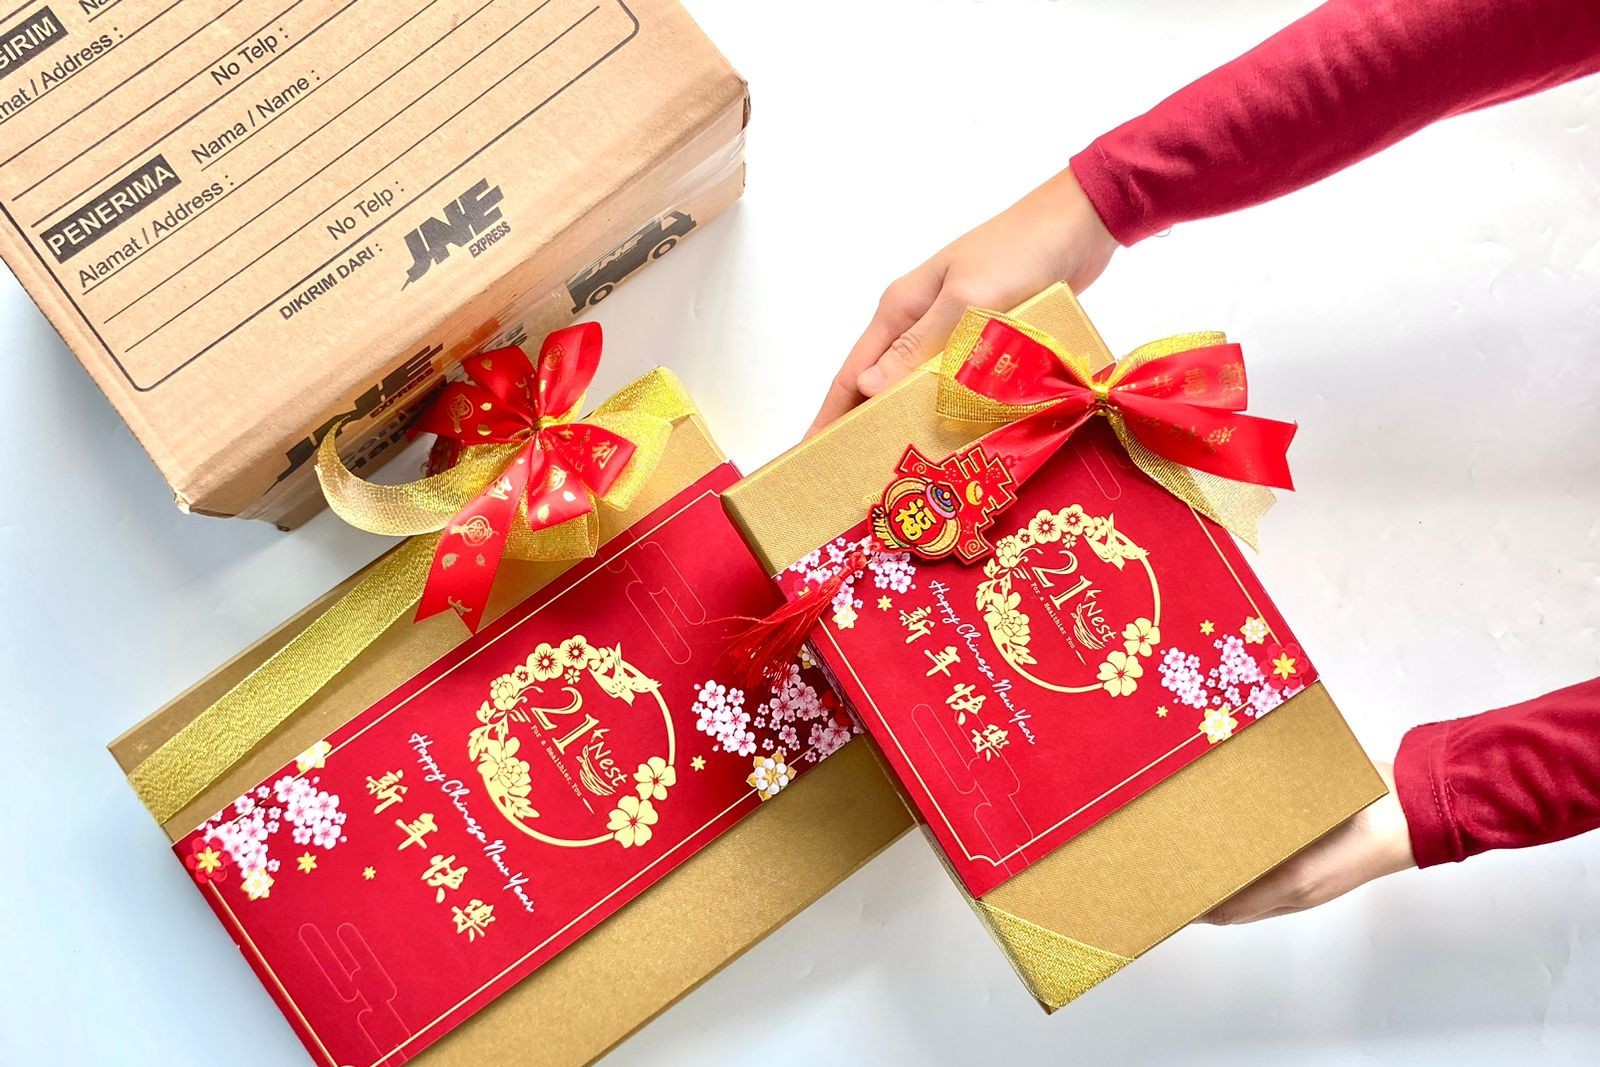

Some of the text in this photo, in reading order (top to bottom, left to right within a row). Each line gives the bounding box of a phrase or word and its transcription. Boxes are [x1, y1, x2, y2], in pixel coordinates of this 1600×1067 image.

[41, 34, 113, 90] Address
[210, 60, 240, 85] No
[238, 32, 279, 64] Telp
[191, 121, 248, 164] Nama
[255, 76, 310, 118] Name
[46, 164, 175, 256] PENERIMA
[78, 237, 140, 288] Alamat
[151, 181, 225, 239] Address
[326, 213, 356, 240] No
[354, 187, 395, 220] Telp
[401, 178, 504, 291] JNE
[468, 221, 511, 258] EXPRESS
[279, 273, 338, 321] DIKIRIM
[336, 246, 375, 280] DARI
[369, 366, 434, 418] EXPRESS
[1030, 582, 1040, 594] For
[1043, 602, 1067, 635] Healthier
[1066, 636, 1076, 649] You
[1031, 549, 1117, 642] 21 Nest
[899, 605, 1010, 761] 新年快樂
[928, 580, 1036, 745] Happy Chinese New Year
[531, 686, 628, 787] 21 Nest
[531, 724, 542, 738] For
[545, 746, 572, 782] Healthier
[571, 783, 582, 797] You
[365, 769, 496, 942] 新年快樂
[408, 732, 534, 912] Happy Chinese New Year
